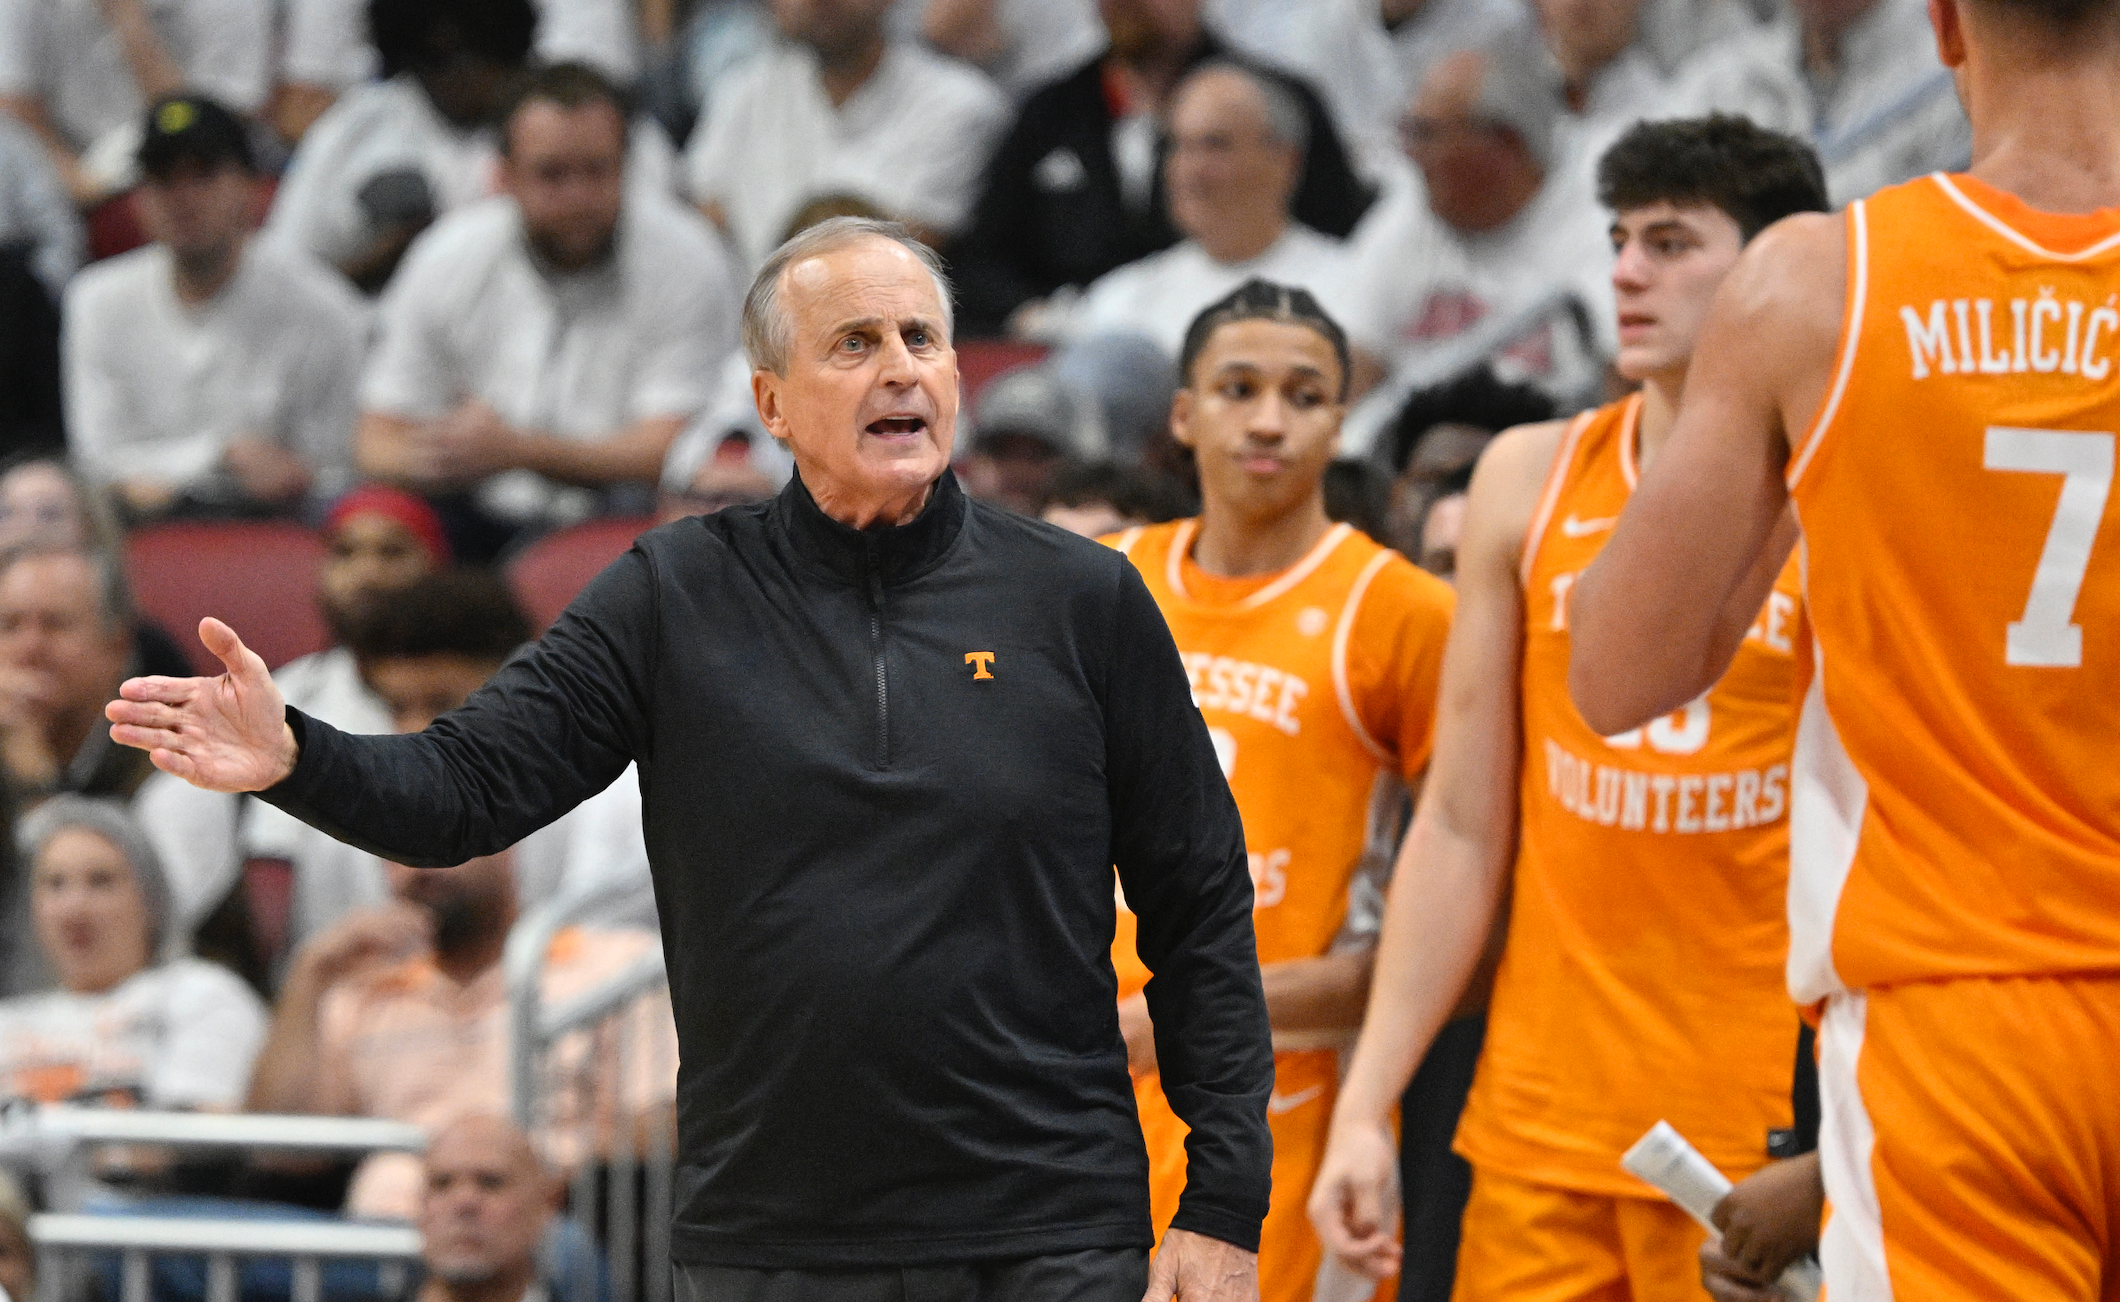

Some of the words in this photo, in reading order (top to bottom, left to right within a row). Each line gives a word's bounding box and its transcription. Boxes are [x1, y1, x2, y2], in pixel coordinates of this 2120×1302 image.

[1983, 425, 2116, 668] 7
[964, 651, 996, 680] T
[1179, 651, 1309, 736] ESSEE
